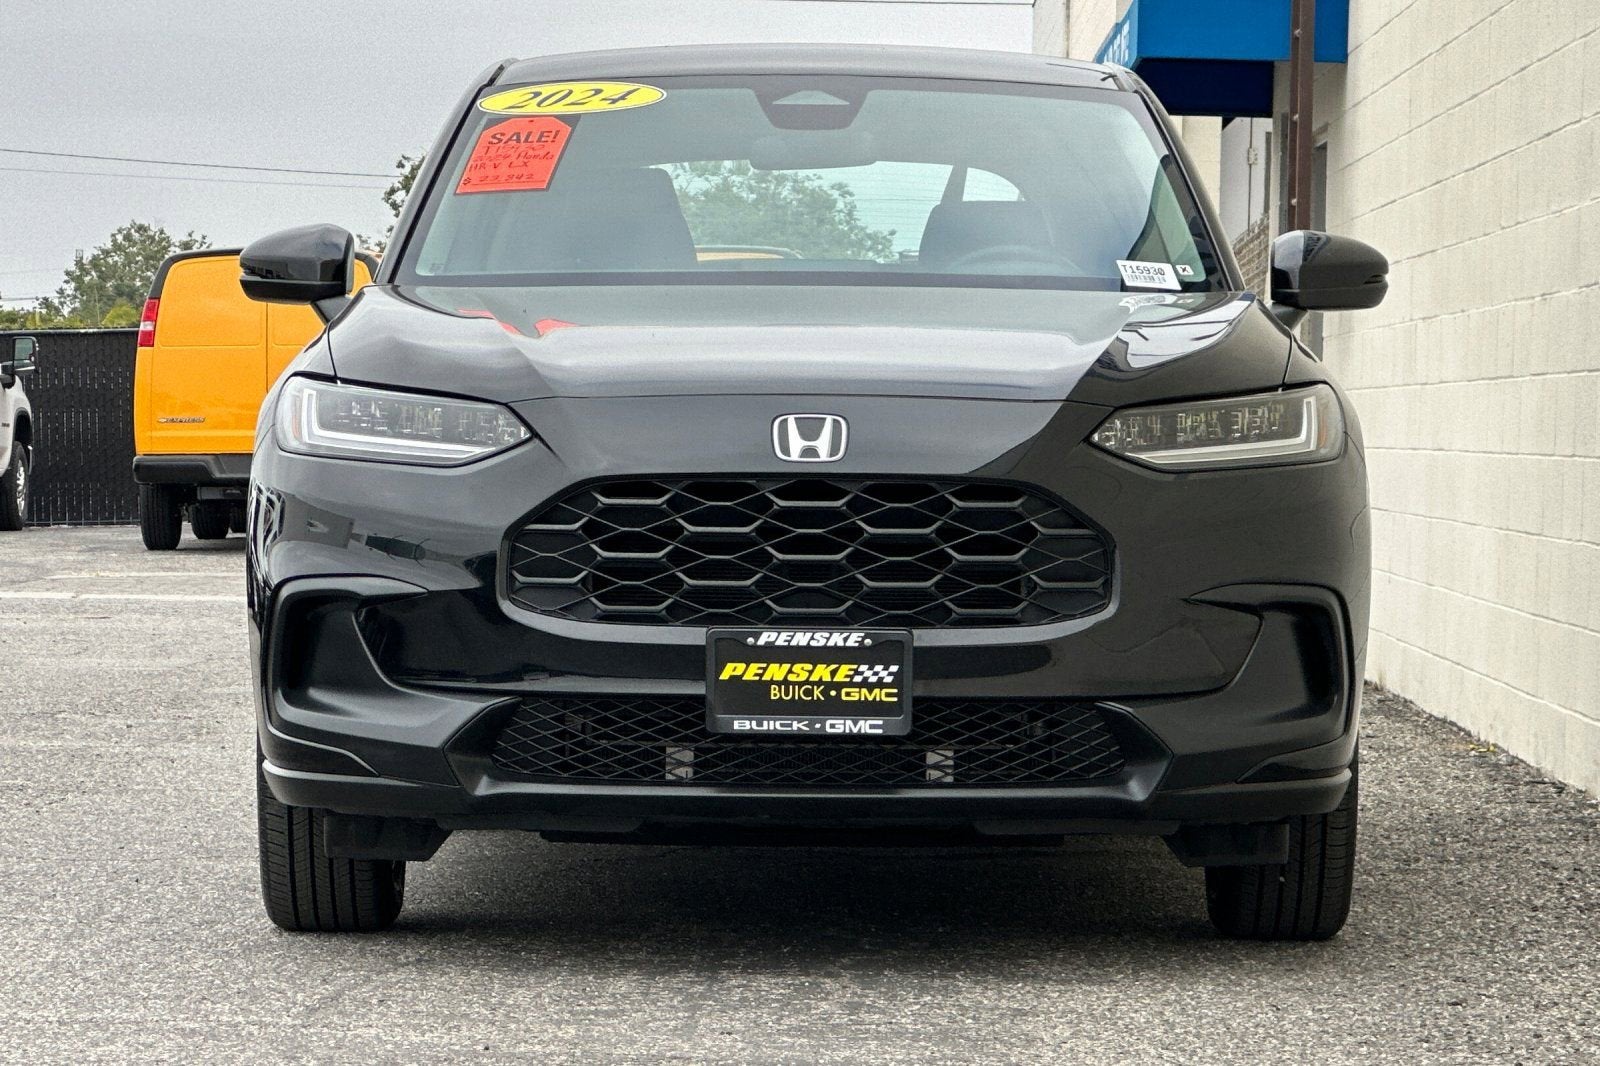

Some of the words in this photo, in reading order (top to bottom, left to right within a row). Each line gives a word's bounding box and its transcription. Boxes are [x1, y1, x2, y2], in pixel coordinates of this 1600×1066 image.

[503, 87, 641, 110] 2024
[488, 129, 560, 145] SALE!
[1120, 264, 1166, 276] T15930
[756, 631, 865, 647] PENSKE
[718, 662, 859, 682] PENSKE
[770, 684, 825, 701] BUICK
[841, 687, 899, 702] GMC
[733, 720, 810, 731] BUICK
[825, 719, 884, 734] GMC
